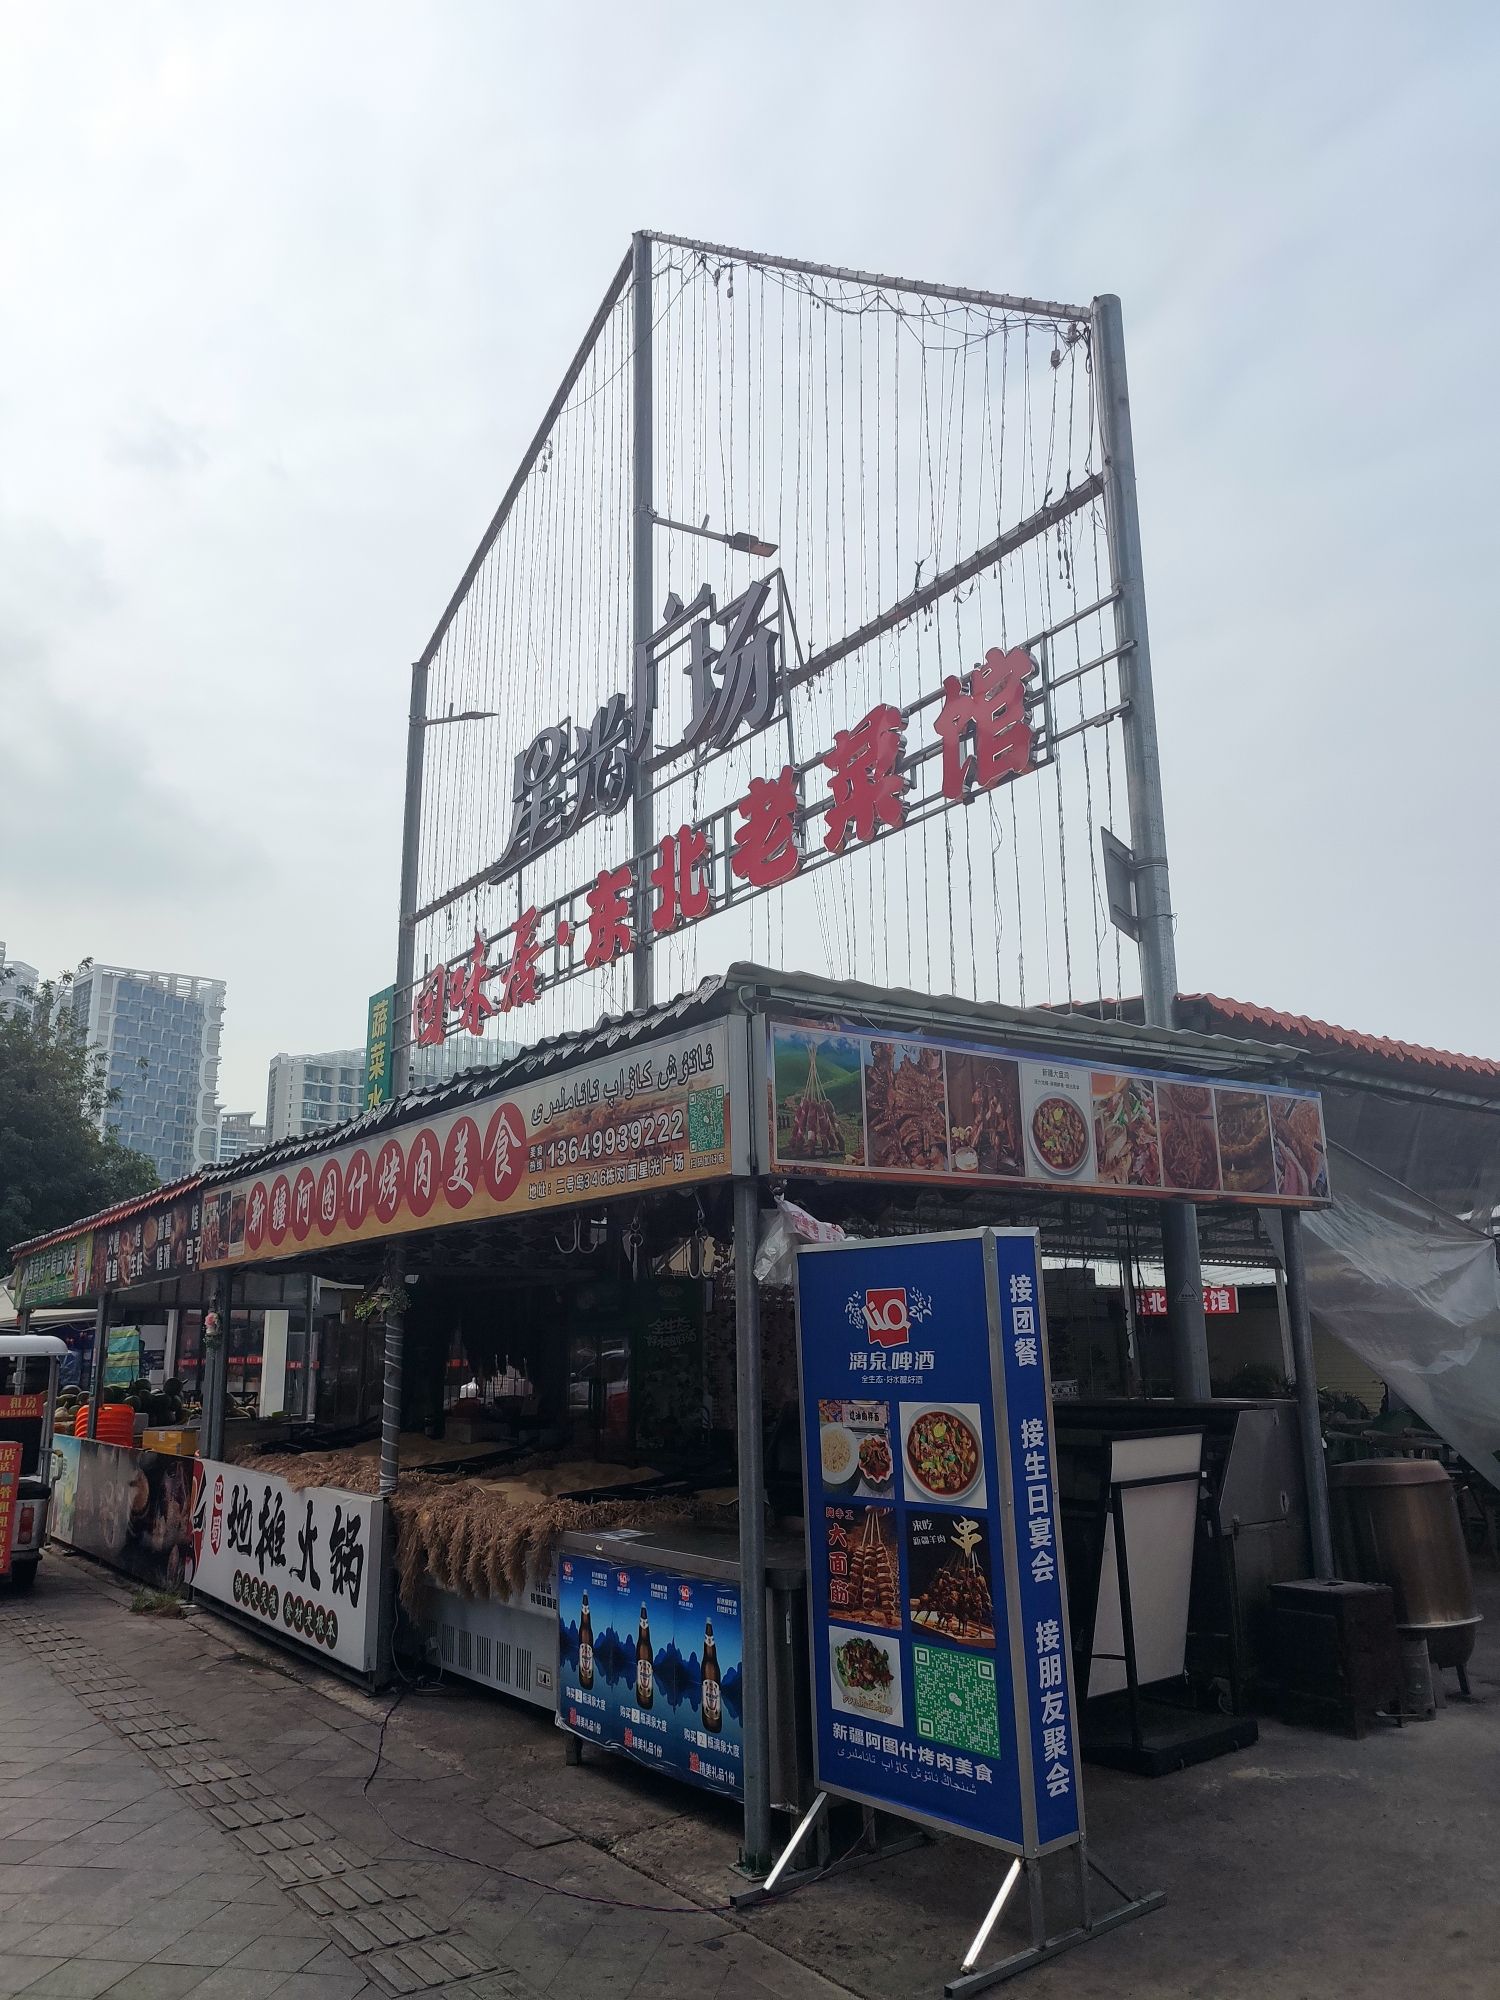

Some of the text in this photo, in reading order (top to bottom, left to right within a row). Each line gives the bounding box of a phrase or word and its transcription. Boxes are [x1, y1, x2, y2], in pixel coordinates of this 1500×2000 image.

[489, 577, 781, 884] 星光广场
[249, 1111, 523, 1233] 新疆阿图什烤肉美食
[546, 1109, 685, 1169] 13649939222
[849, 1350, 936, 1371] 漓泉啤酒
[1009, 1273, 1038, 1368] 接团餐
[1020, 1418, 1055, 1584] 接生日宴会
[828, 1522, 850, 1605] 大面筋
[832, 1722, 993, 1785] 新疆阿图什烤肉美食
[1035, 1618, 1070, 1799] 接朋友聚会
